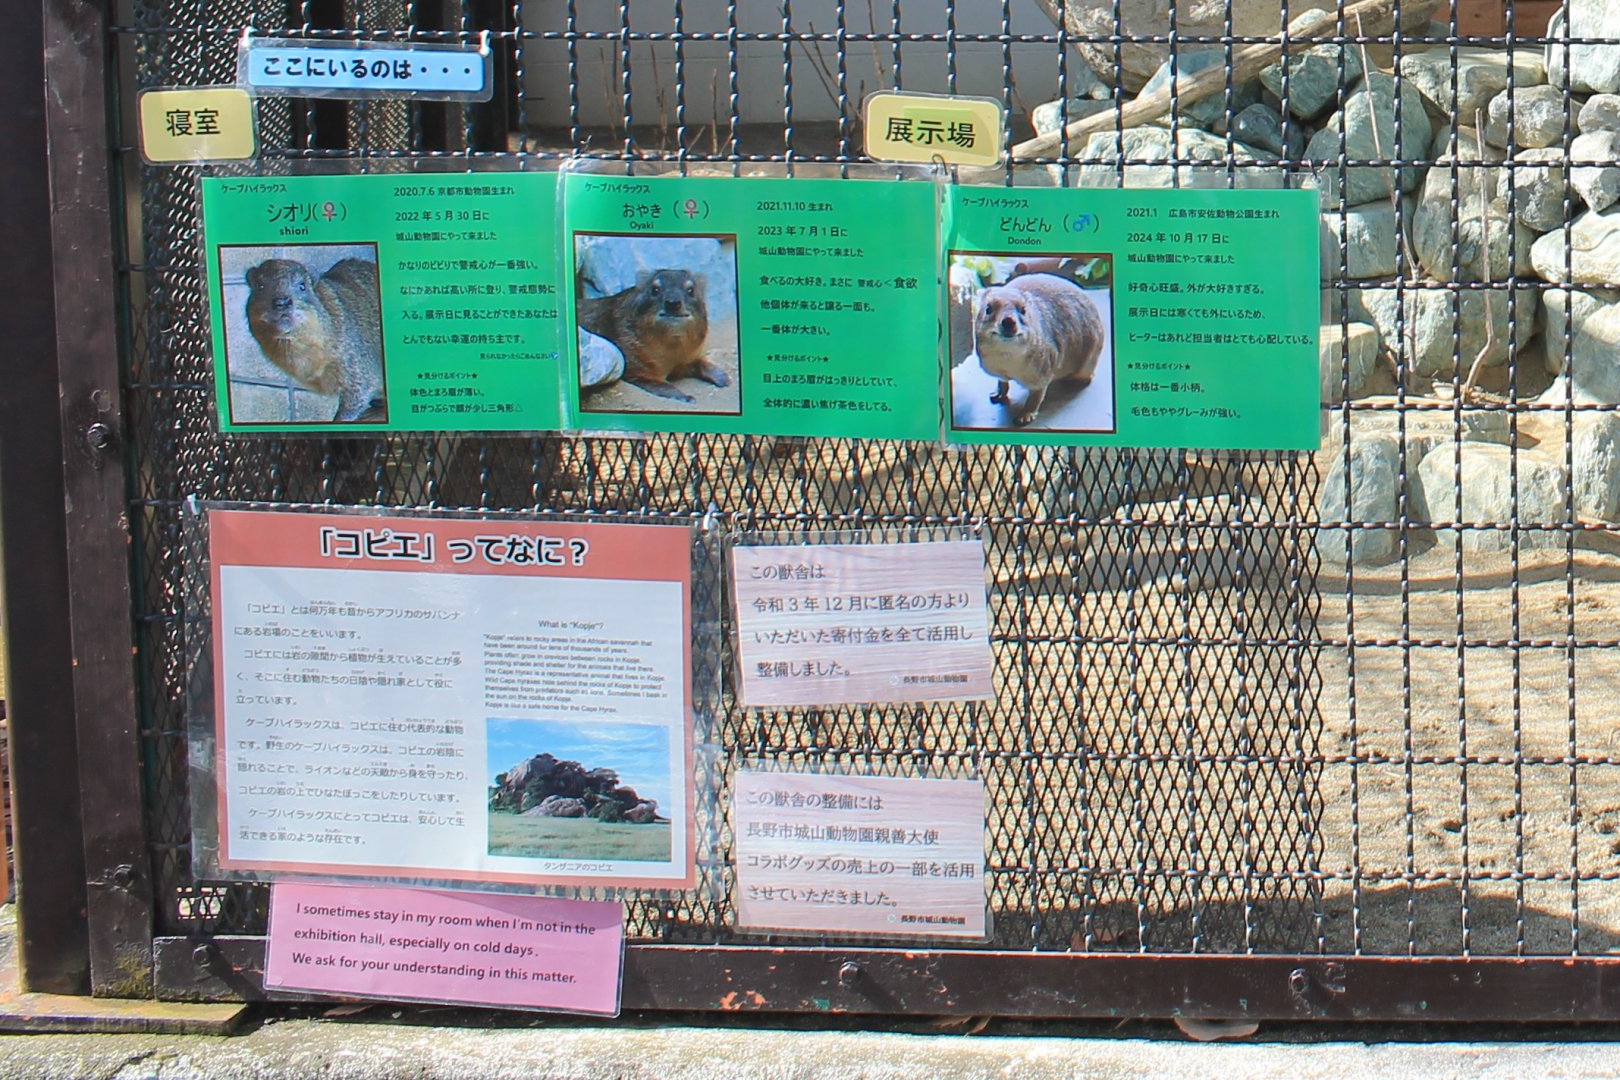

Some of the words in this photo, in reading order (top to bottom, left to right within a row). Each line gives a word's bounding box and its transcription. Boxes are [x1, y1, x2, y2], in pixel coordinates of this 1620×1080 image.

[165, 108, 221, 138] 寝室
[885, 116, 976, 149] 展示場
[220, 184, 288, 194] ケープハイラックス
[585, 182, 651, 194] ケープハイラックス
[962, 197, 1029, 208] ケープハイラックス
[279, 226, 309, 237] shiori
[630, 221, 654, 231] Oyaki
[1007, 236, 1042, 245] Dondon
[320, 528, 588, 566] 「コピエ」ってなに？
[750, 564, 826, 580] この獣舎は
[754, 625, 974, 645] いただいた寄付金を全て活用し
[757, 660, 851, 678] 整備しました。
[746, 790, 884, 811] この獣舎の整備には
[746, 822, 940, 846] 長野市城山動物園親善大使
[746, 854, 975, 879] コラボグッズの売上の一部を活用
[748, 885, 898, 908] させていただきました。
[303, 904, 371, 919] sometimes
[373, 909, 399, 925] stay
[401, 909, 414, 923] in
[416, 913, 436, 927] my
[439, 915, 473, 927] room
[475, 915, 510, 929] when
[512, 917, 534, 931] I'm
[536, 919, 558, 933] not
[560, 920, 573, 933] in
[575, 922, 596, 935] the
[294, 928, 357, 944] exhibition
[359, 931, 386, 947] hall,
[389, 934, 451, 952] especially
[453, 940, 470, 952] on
[474, 940, 501, 954] cold
[292, 952, 312, 965] We
[315, 953, 336, 967] ask
[339, 955, 358, 968] for
[360, 959, 390, 973] your
[393, 961, 486, 980] understanding
[488, 966, 502, 979] in
[504, 967, 529, 981] this
[531, 971, 577, 985] matter.
